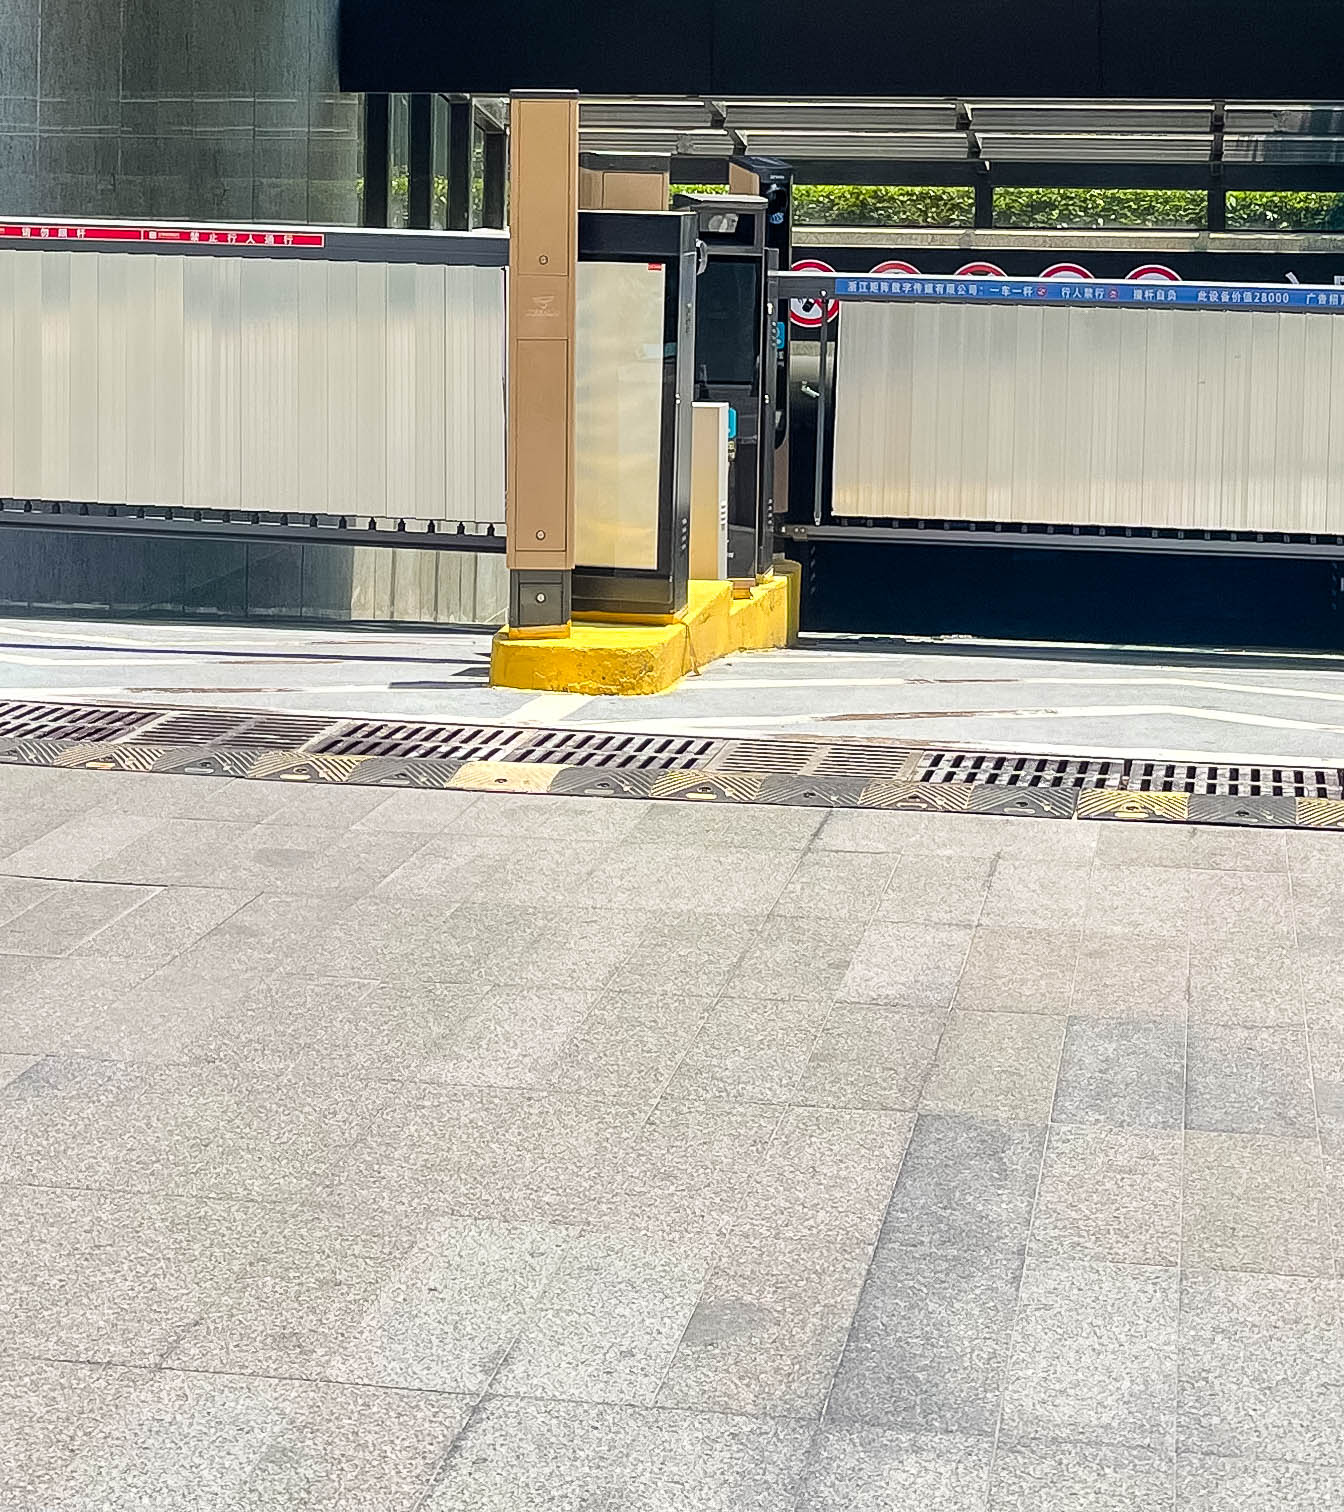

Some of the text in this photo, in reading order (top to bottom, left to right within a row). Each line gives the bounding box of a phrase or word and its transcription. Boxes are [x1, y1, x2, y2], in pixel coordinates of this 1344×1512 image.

[189, 231, 294, 246] 禁止行人通行
